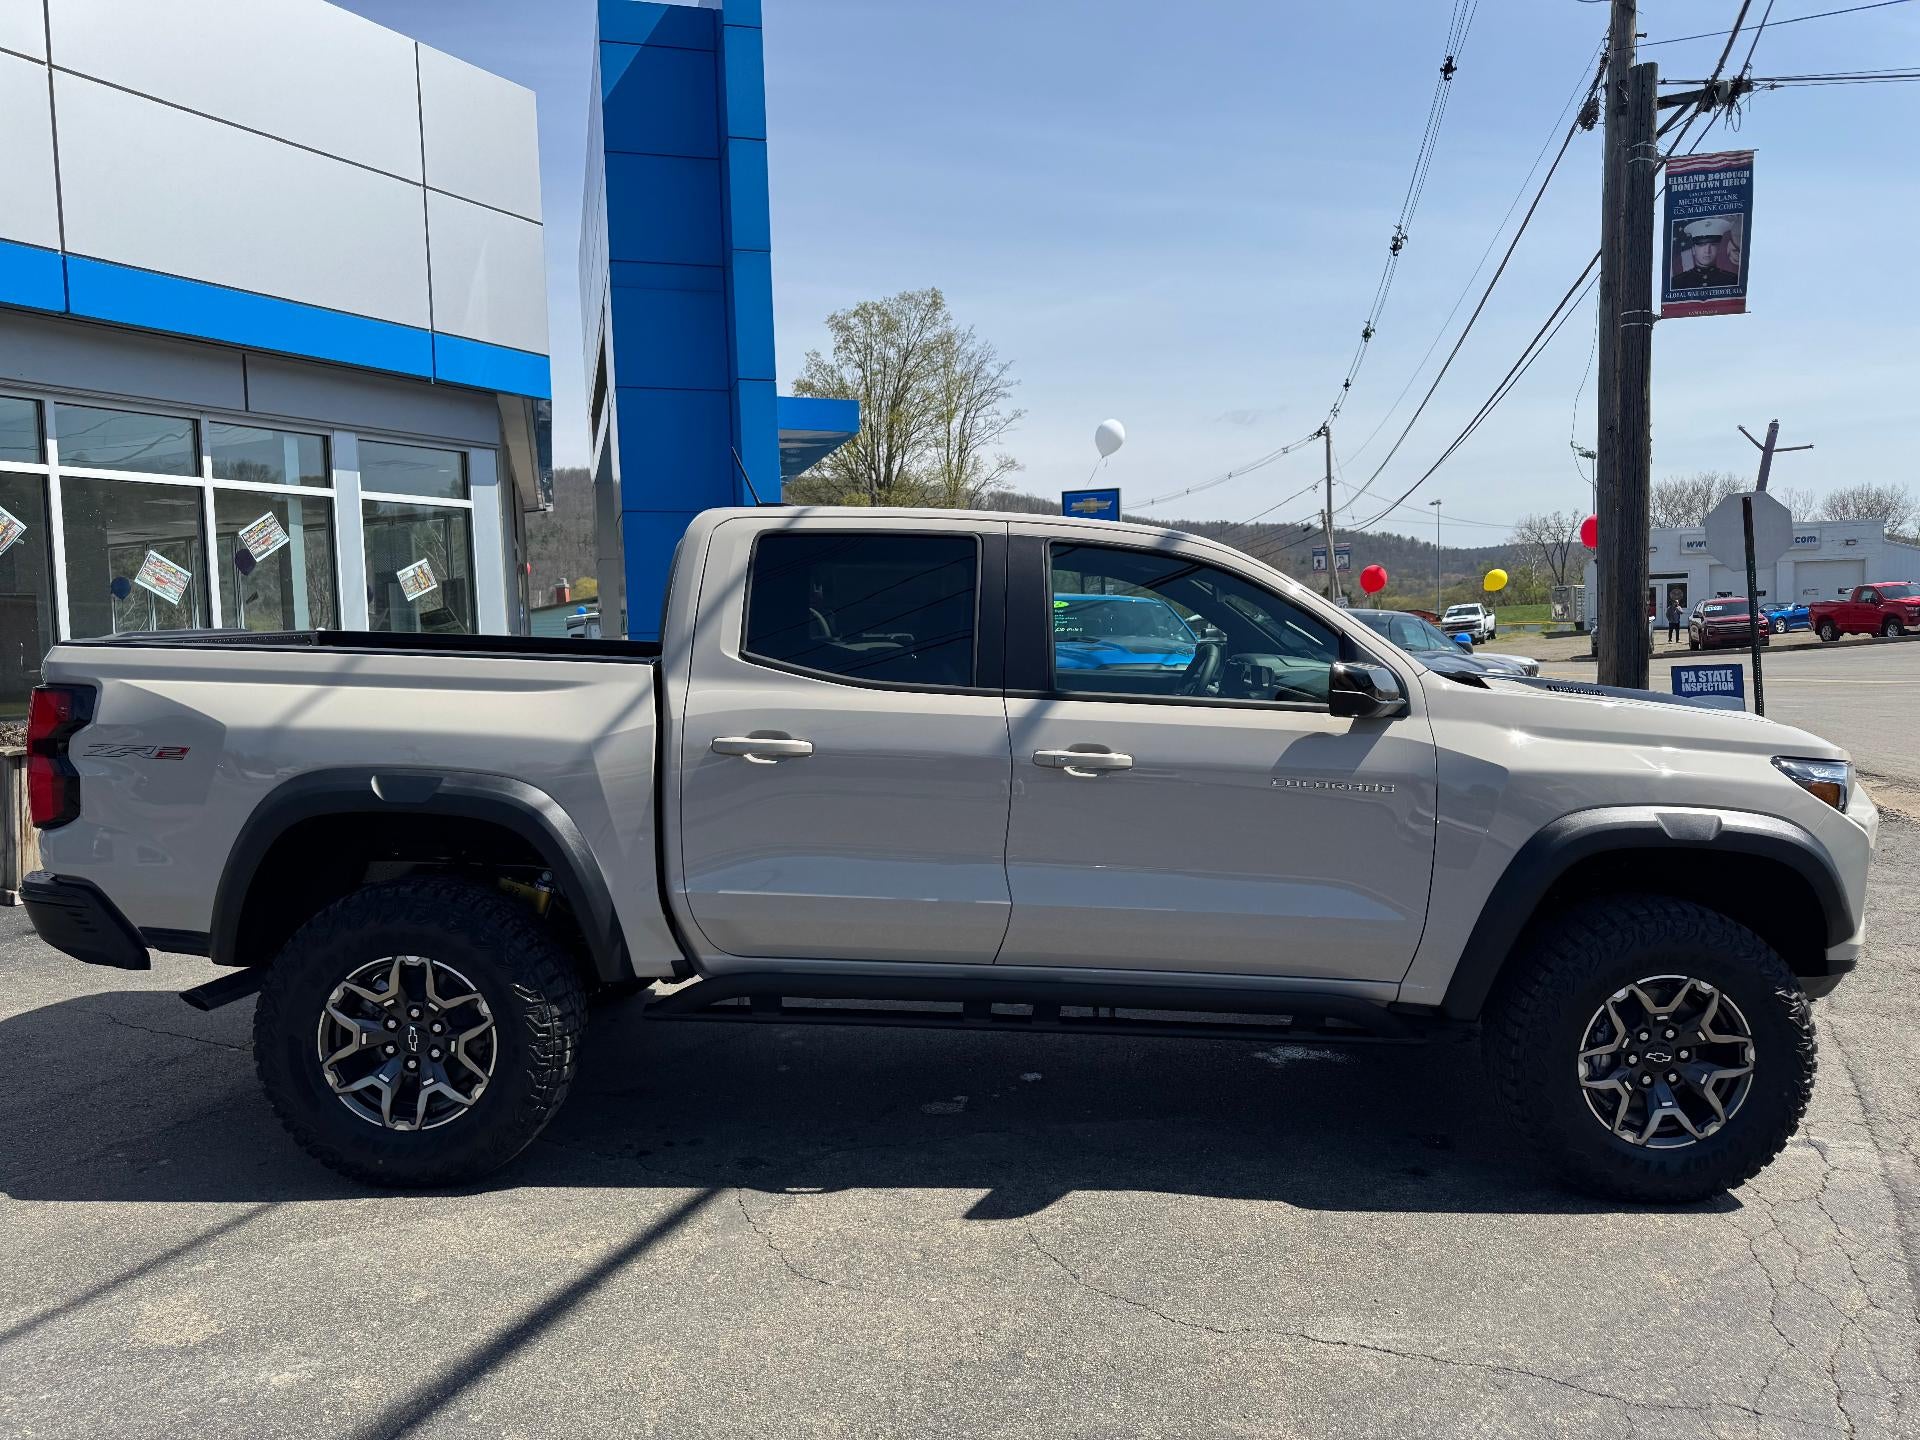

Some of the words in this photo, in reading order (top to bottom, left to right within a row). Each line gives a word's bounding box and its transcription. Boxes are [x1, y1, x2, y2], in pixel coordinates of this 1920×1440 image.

[1668, 174, 1705, 185] ELKLAND
[1708, 170, 1750, 180] BOROUGH
[1671, 181, 1720, 192] HOMETOWN
[1723, 178, 1747, 187] HERO
[1678, 196, 1712, 206] MICHAEL
[1714, 193, 1738, 203] PLANK
[1687, 204, 1717, 214] MARINE
[1718, 202, 1744, 211] CORPS
[1680, 671, 1697, 683] PA
[1698, 669, 1734, 683] STATE
[1681, 681, 1735, 692] INSPECTION
[82, 743, 191, 761] ZR2
[1271, 778, 1395, 793] COLORADO
